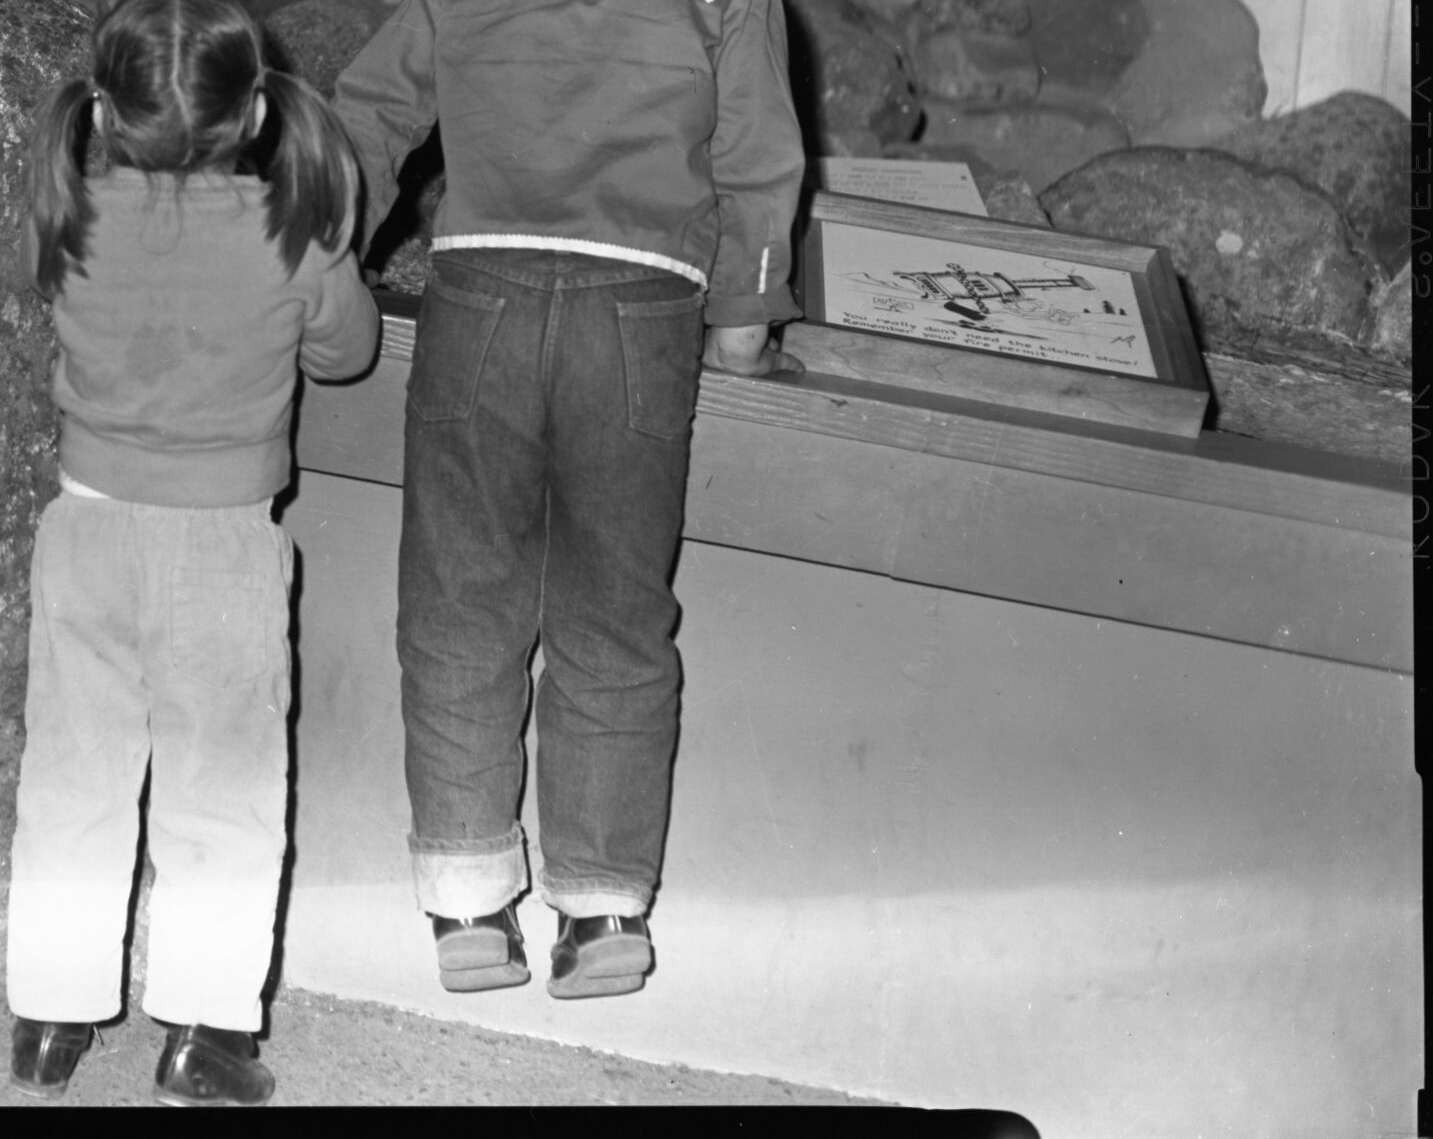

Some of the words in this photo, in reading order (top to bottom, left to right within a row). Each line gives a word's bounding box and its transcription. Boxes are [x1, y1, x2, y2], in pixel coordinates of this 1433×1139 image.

[843, 318, 914, 334] Remember
[922, 332, 957, 341] your
[963, 338, 991, 348] fire
[843, 311, 868, 321] You
[876, 318, 917, 330] really
[965, 333, 1000, 344] need
[1008, 339, 1033, 348] the
[1039, 345, 1091, 359] kitchen
